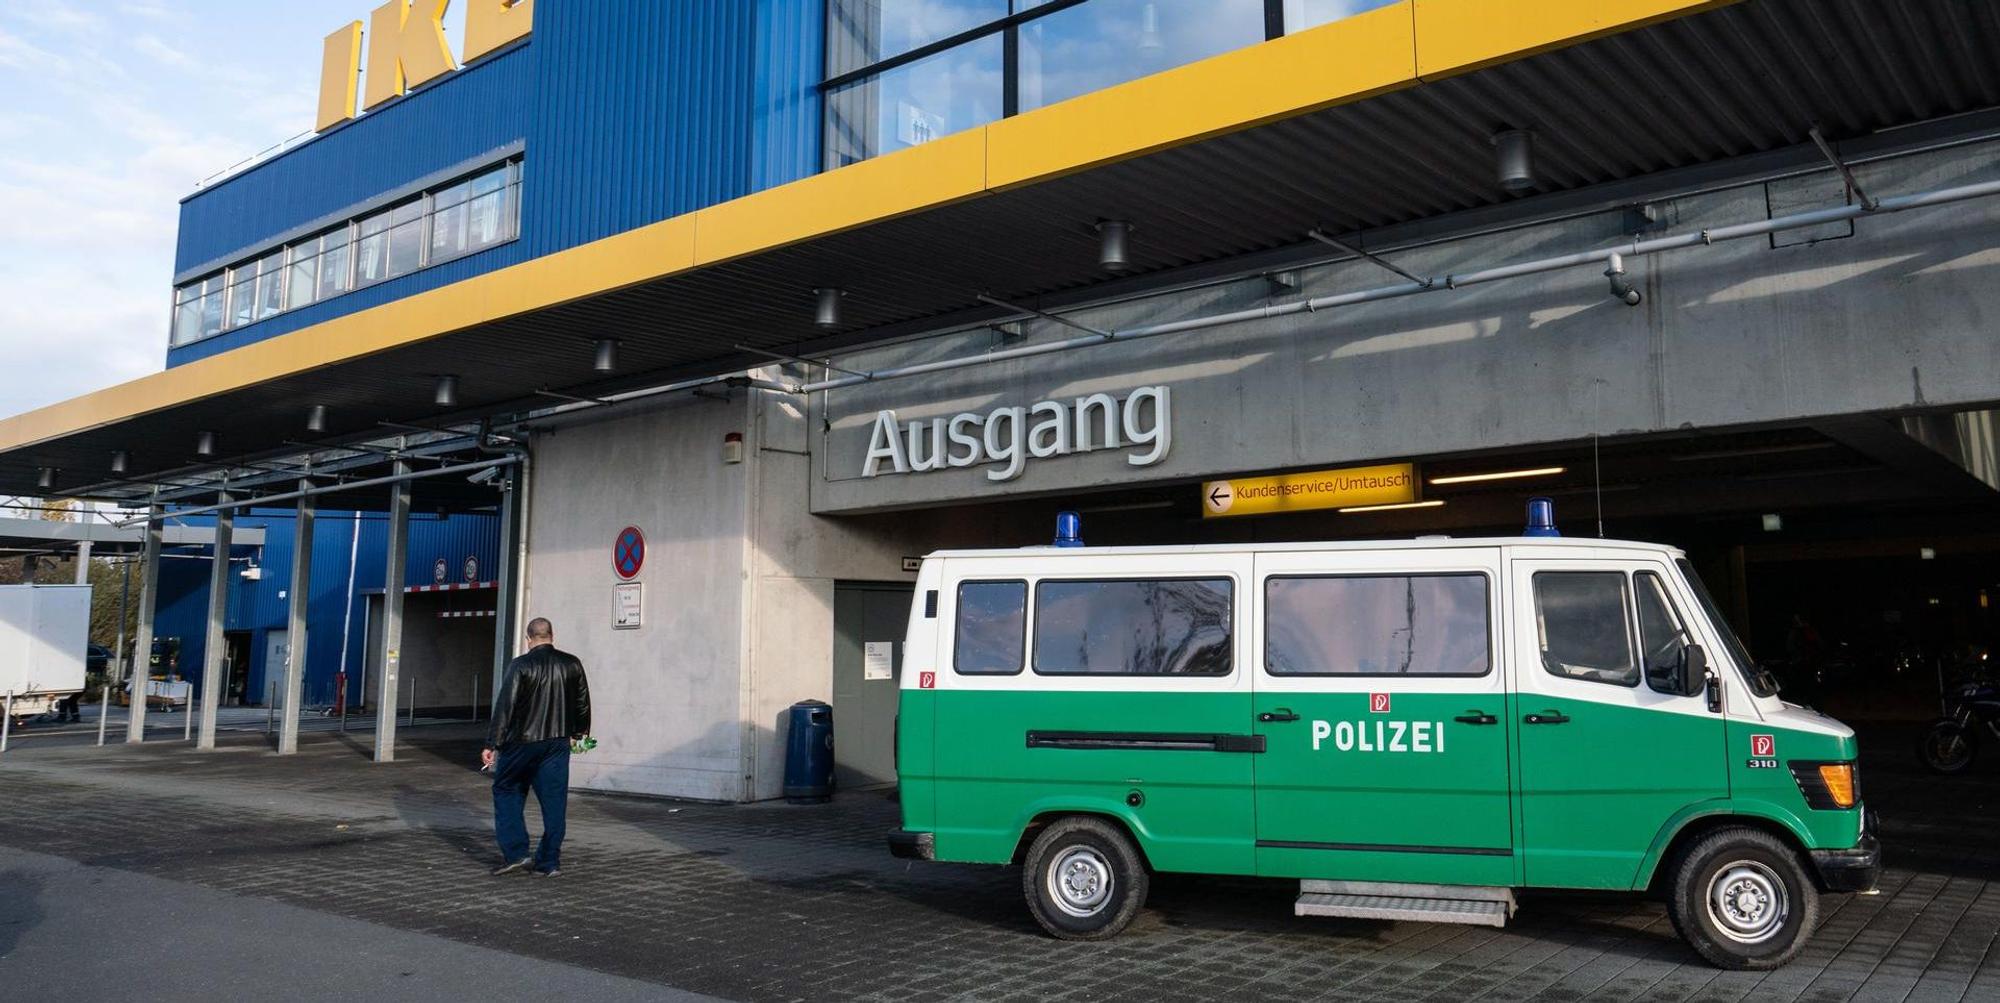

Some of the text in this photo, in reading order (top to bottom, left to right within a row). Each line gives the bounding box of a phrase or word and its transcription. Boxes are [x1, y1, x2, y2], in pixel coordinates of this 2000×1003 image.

[861, 385, 1171, 481] Ausgang
[1236, 471, 1411, 499] Kundenservice/Umtausch
[1312, 720, 1445, 753] POLIZEI
[1749, 759, 1777, 768] 310
